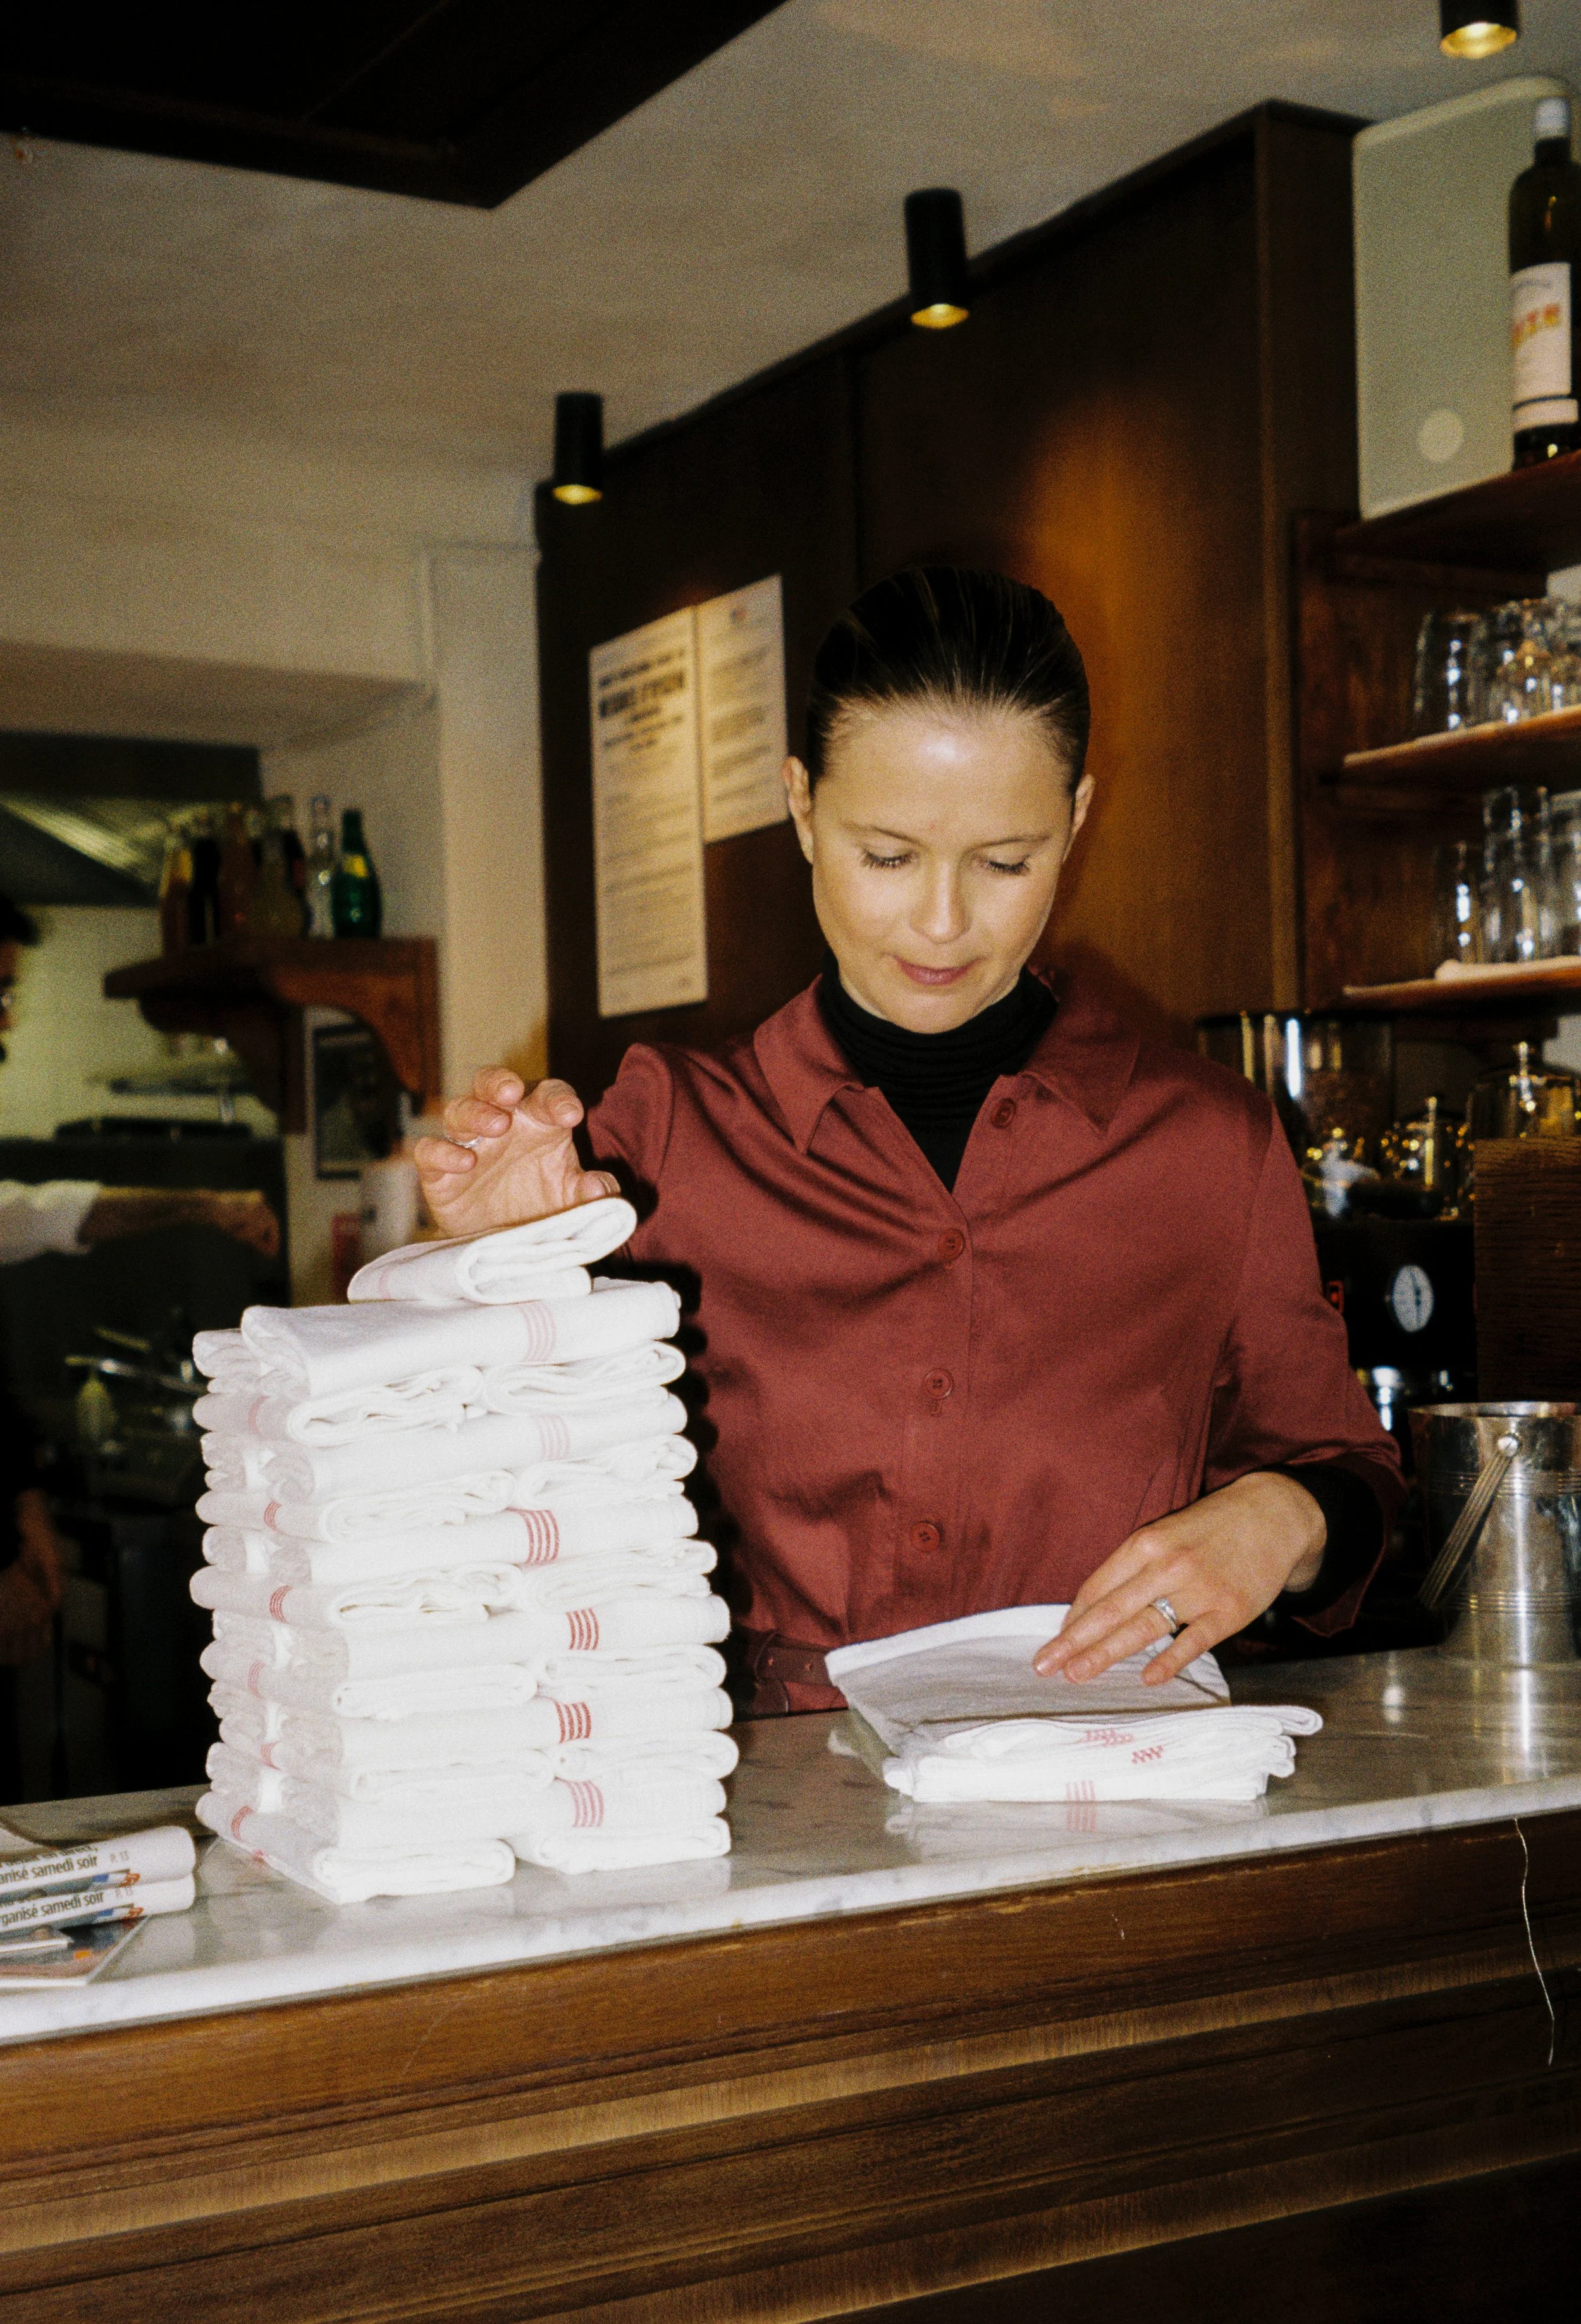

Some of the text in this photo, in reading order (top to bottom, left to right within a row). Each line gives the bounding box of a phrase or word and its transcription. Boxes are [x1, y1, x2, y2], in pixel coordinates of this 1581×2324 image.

[31, 1857, 75, 1879] samedi
[77, 1853, 97, 1870] soir
[40, 1894, 82, 1917] samedi
[83, 1891, 104, 1906] soir
